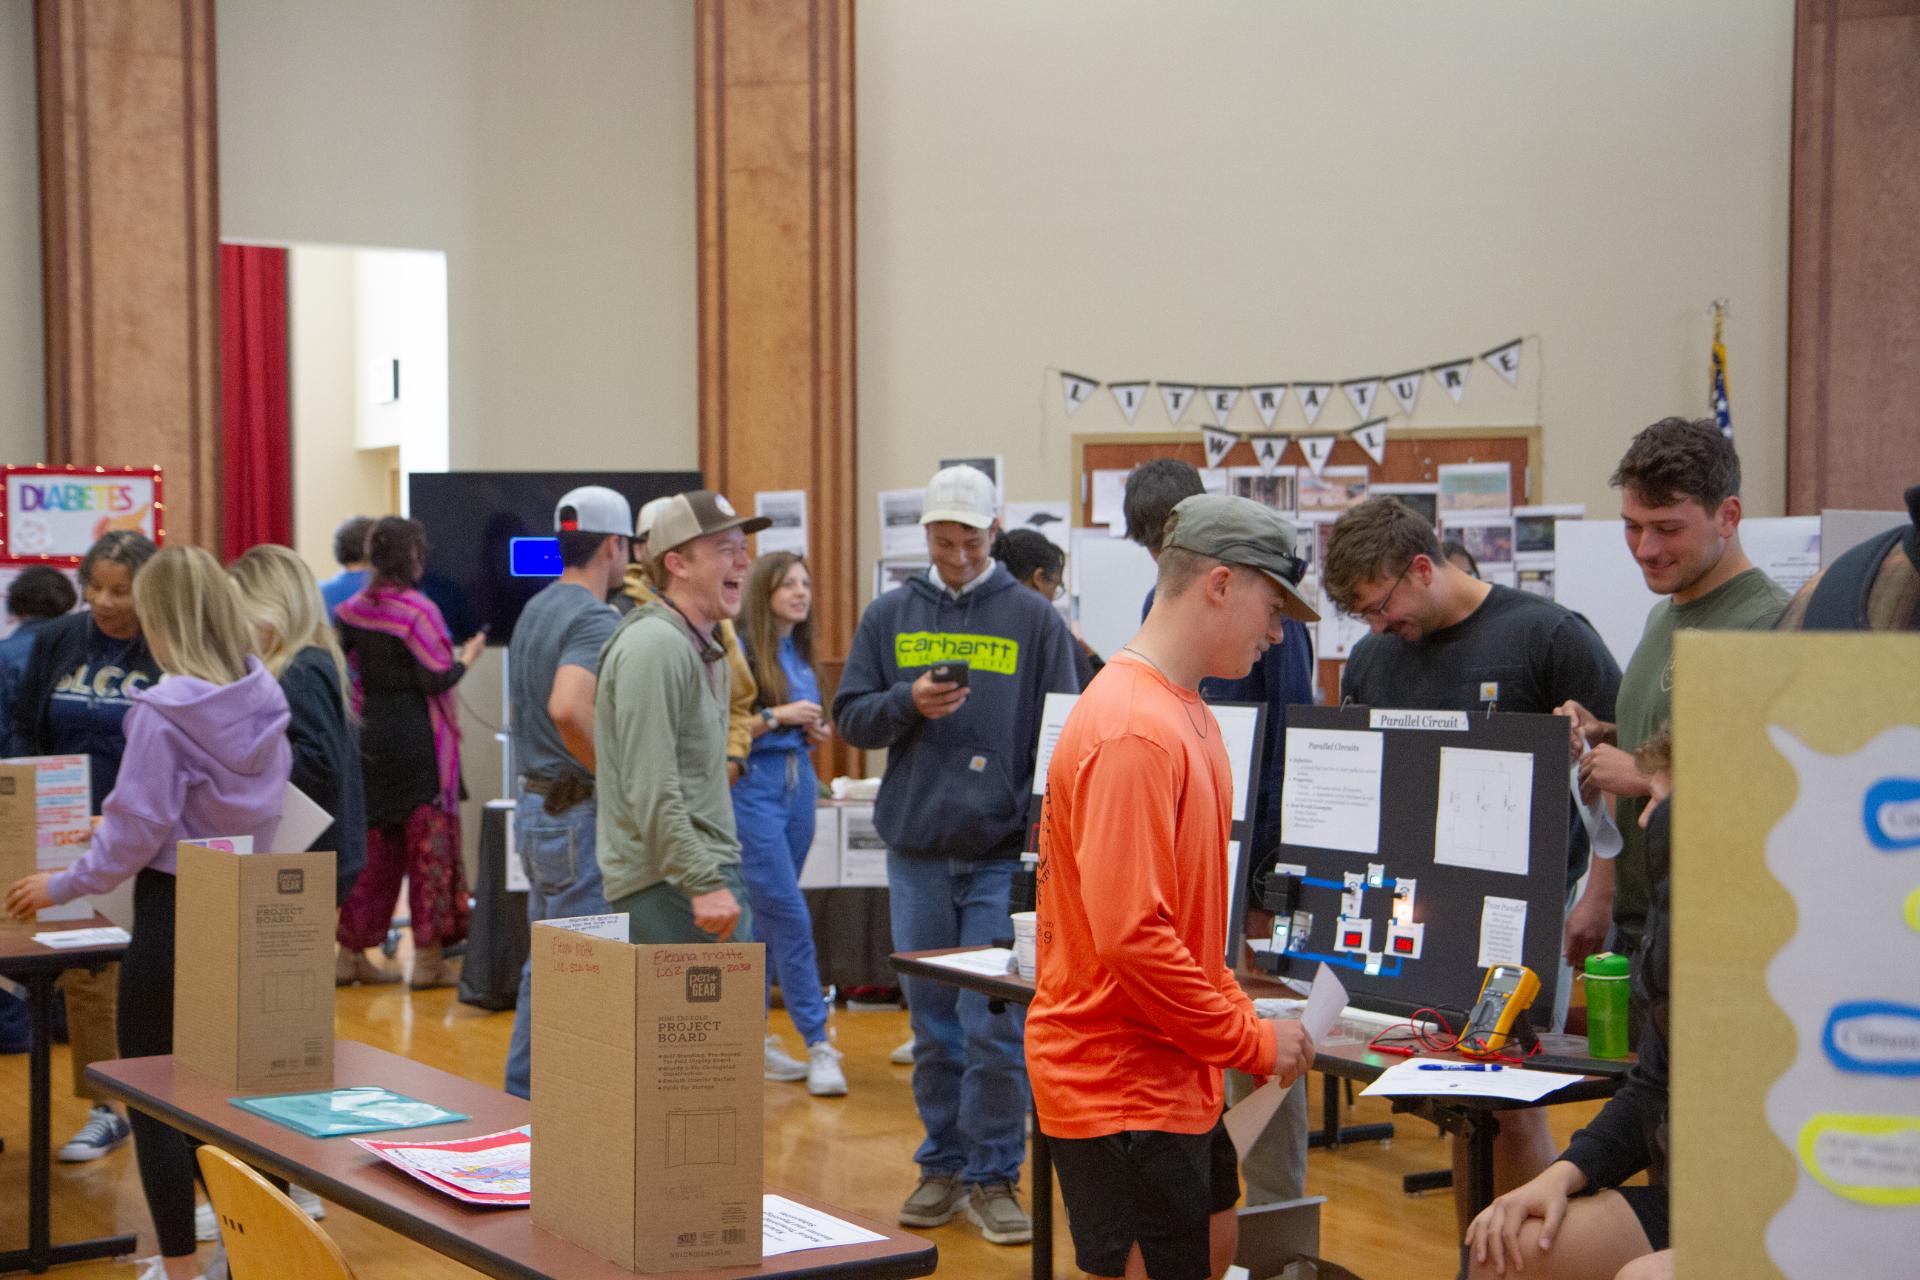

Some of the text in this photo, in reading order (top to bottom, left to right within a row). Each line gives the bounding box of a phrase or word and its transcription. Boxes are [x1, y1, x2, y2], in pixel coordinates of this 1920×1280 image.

[1070, 353, 1516, 411] LITERATURE
[1209, 432, 1380, 460] WALL
[19, 484, 133, 512] DIABETES
[899, 637, 1011, 659] carhartt
[1379, 714, 1458, 728] Parallel Circuit
[256, 907, 304, 916] PROJECT
[256, 915, 293, 924] BOARD
[692, 983, 717, 997] GEAR
[658, 1021, 721, 1032] PROJECT
[658, 1033, 707, 1042] BOARD
